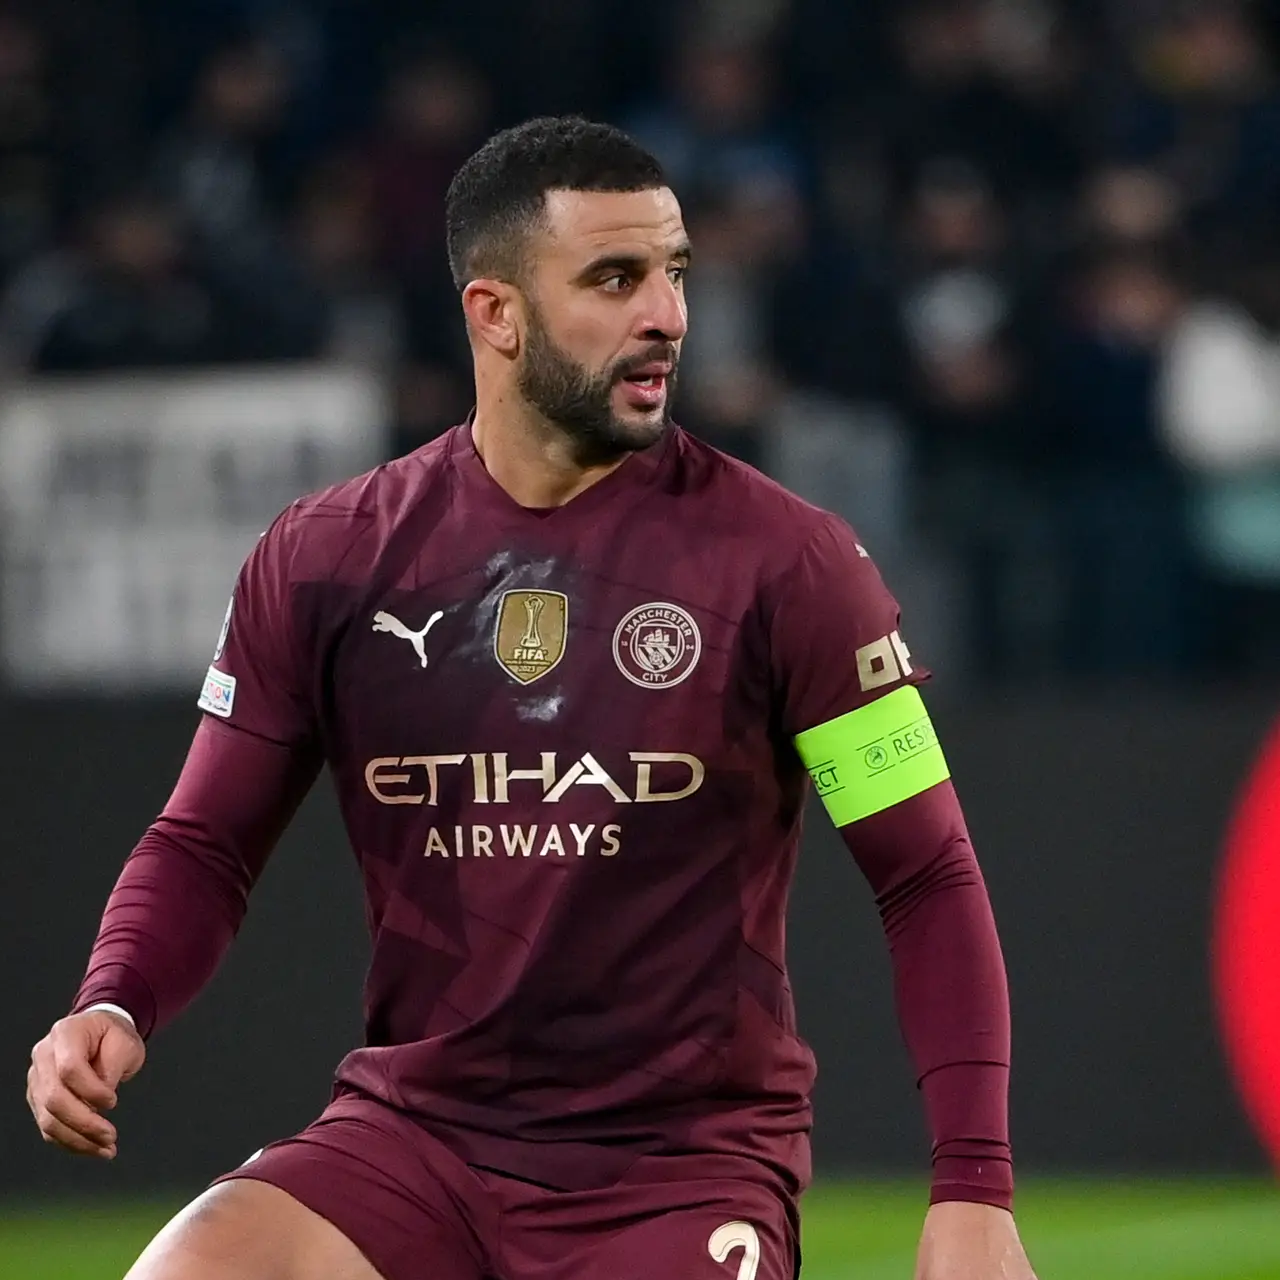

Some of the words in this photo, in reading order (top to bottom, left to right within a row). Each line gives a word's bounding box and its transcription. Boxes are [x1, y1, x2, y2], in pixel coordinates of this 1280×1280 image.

[624, 609, 692, 635] MANCHESTER
[513, 648, 546, 661] FIFA
[642, 672, 669, 683] CITY
[364, 751, 706, 806] ETIHAD
[424, 823, 622, 858] AIRWAYS
